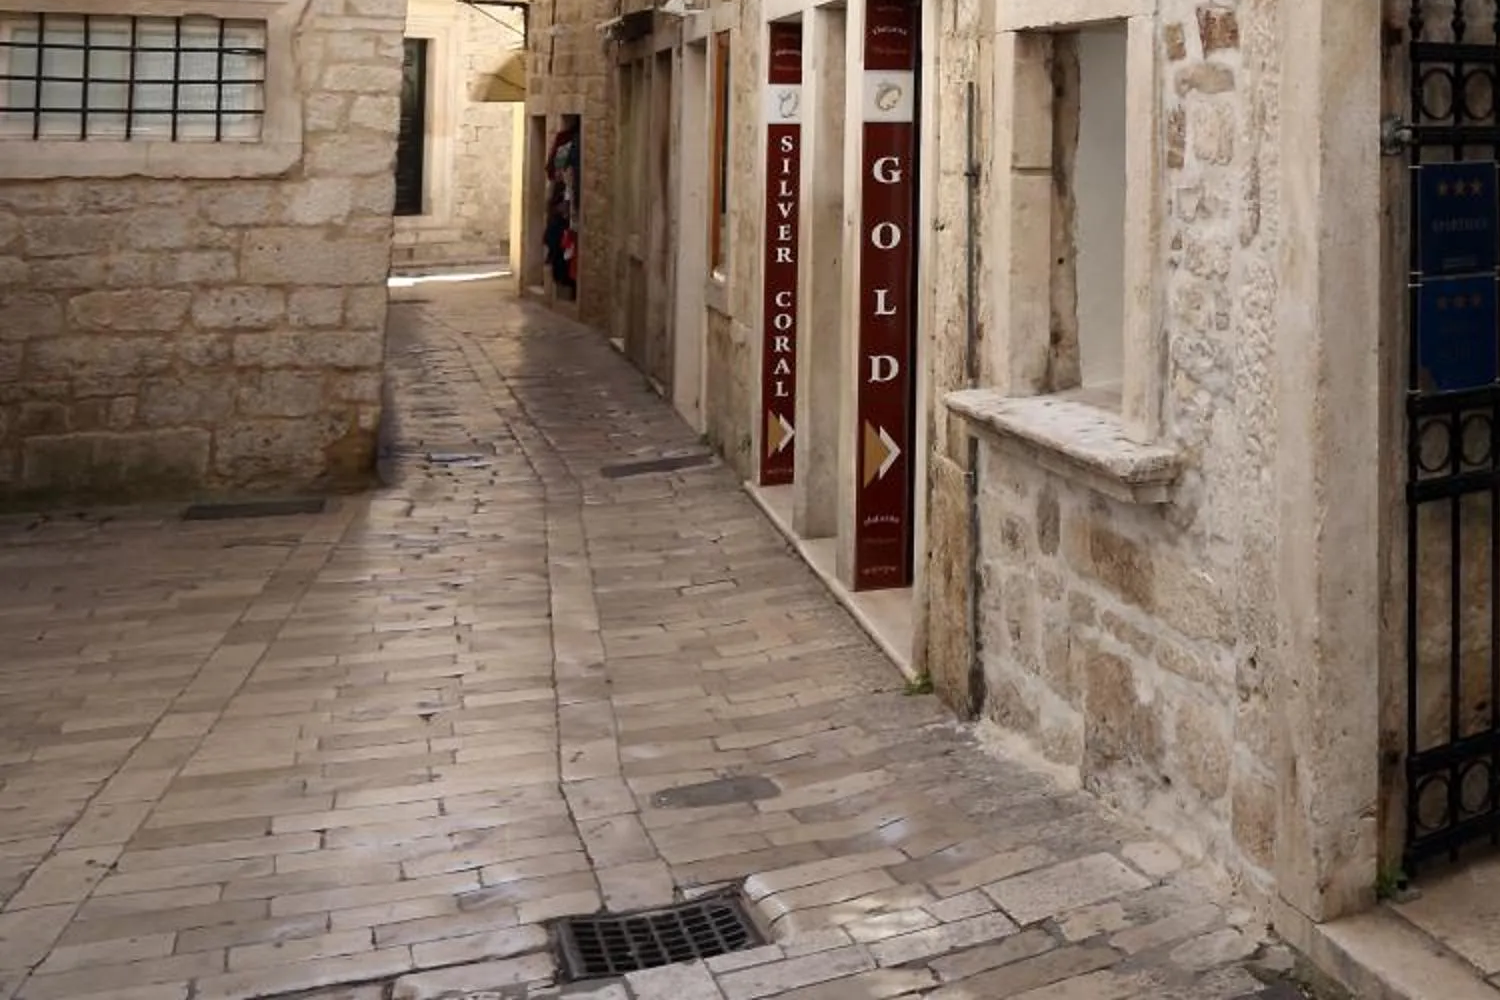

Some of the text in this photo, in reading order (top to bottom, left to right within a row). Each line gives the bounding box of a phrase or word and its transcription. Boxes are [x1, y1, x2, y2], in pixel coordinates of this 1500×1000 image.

[773, 135, 794, 398] SILVER CORAL
[867, 155, 902, 384] GOLD
